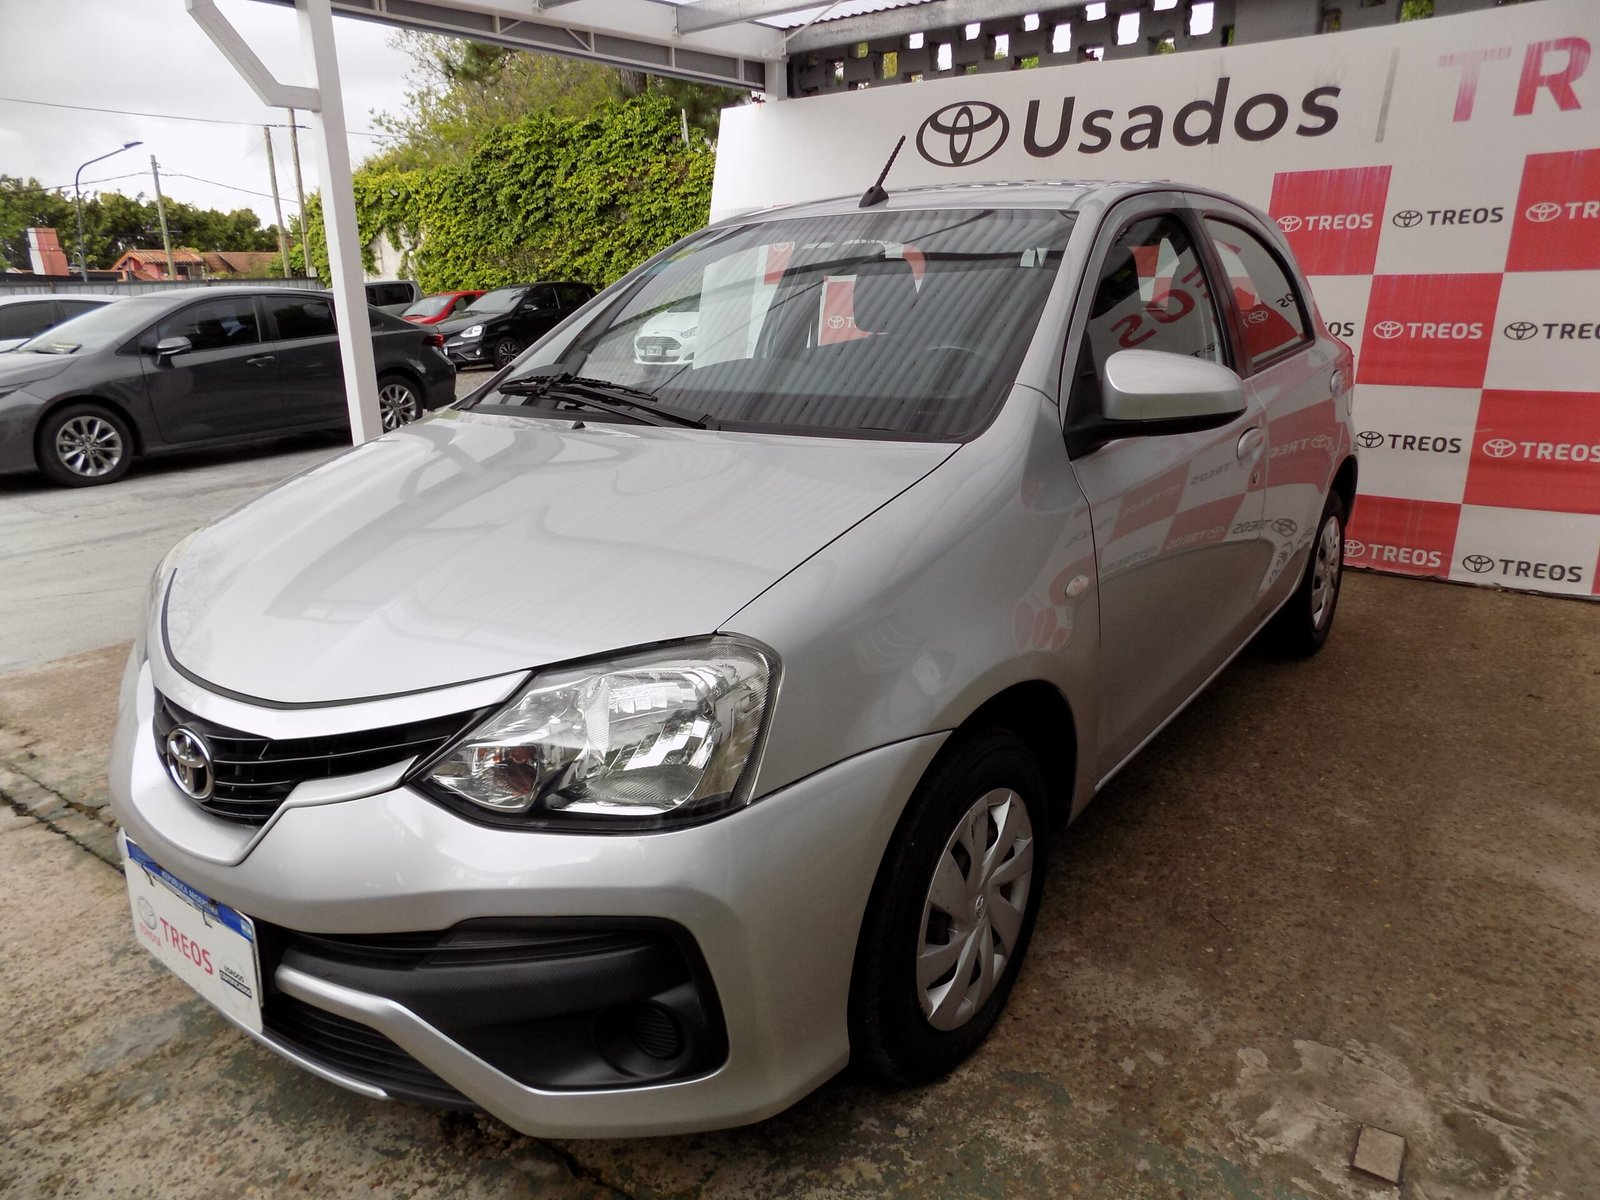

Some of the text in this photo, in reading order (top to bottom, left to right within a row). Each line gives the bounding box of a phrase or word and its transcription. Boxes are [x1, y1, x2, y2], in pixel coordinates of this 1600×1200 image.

[1022, 77, 1341, 158] Usados
[1305, 212, 1374, 231] TREOS
[1426, 206, 1504, 226] TREOS
[1406, 322, 1484, 340] TREOS
[1387, 433, 1463, 454] TREOS
[1519, 441, 1600, 463] TREOS
[1368, 543, 1443, 568] TREOS
[1498, 558, 1584, 584] TREOS
[159, 917, 214, 975] TREOS
